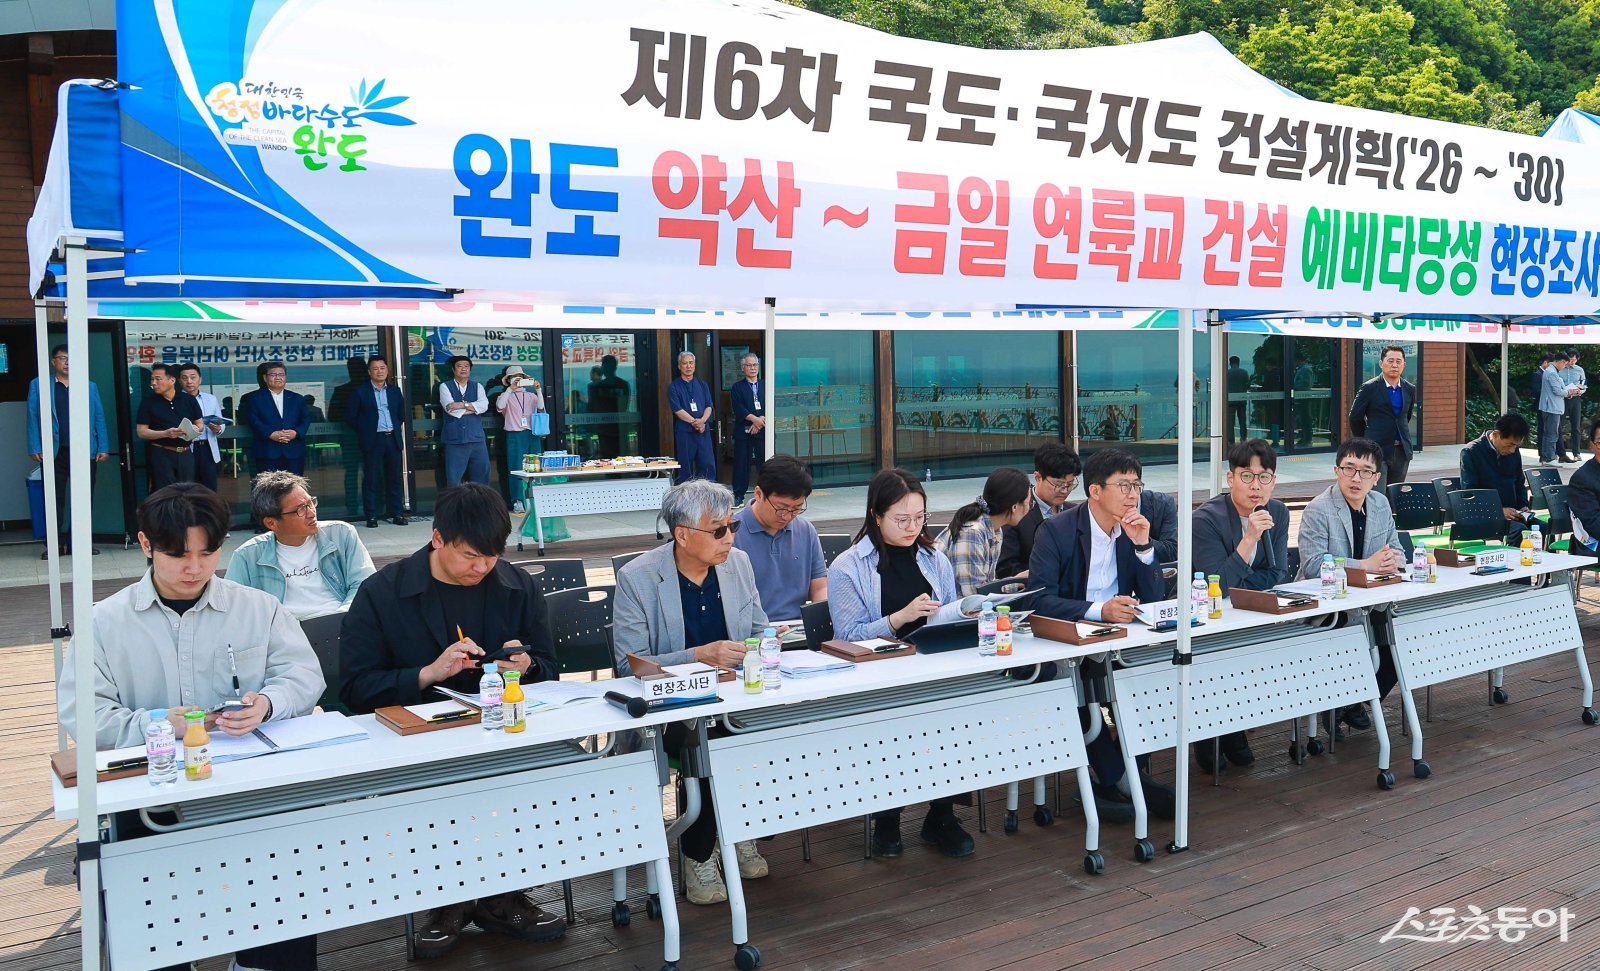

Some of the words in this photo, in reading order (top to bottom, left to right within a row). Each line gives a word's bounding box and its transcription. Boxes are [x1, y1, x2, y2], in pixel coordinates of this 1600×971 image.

[621, 27, 842, 133] 제6차
[245, 82, 304, 100] 대한민국
[253, 135, 274, 143] CLEAN
[262, 128, 287, 136] CAPITAL
[261, 143, 288, 151] WANDO
[292, 125, 368, 172] 완도
[453, 133, 620, 258] 완도
[652, 150, 801, 269] 약산
[894, 171, 1010, 278] 금일
[1033, 182, 1184, 283] 연륙교
[1202, 199, 1288, 289] 건설
[1302, 206, 1482, 297] 예비타당성
[1491, 223, 1600, 298] 현장조사
[652, 676, 710, 696] 현장조사단
